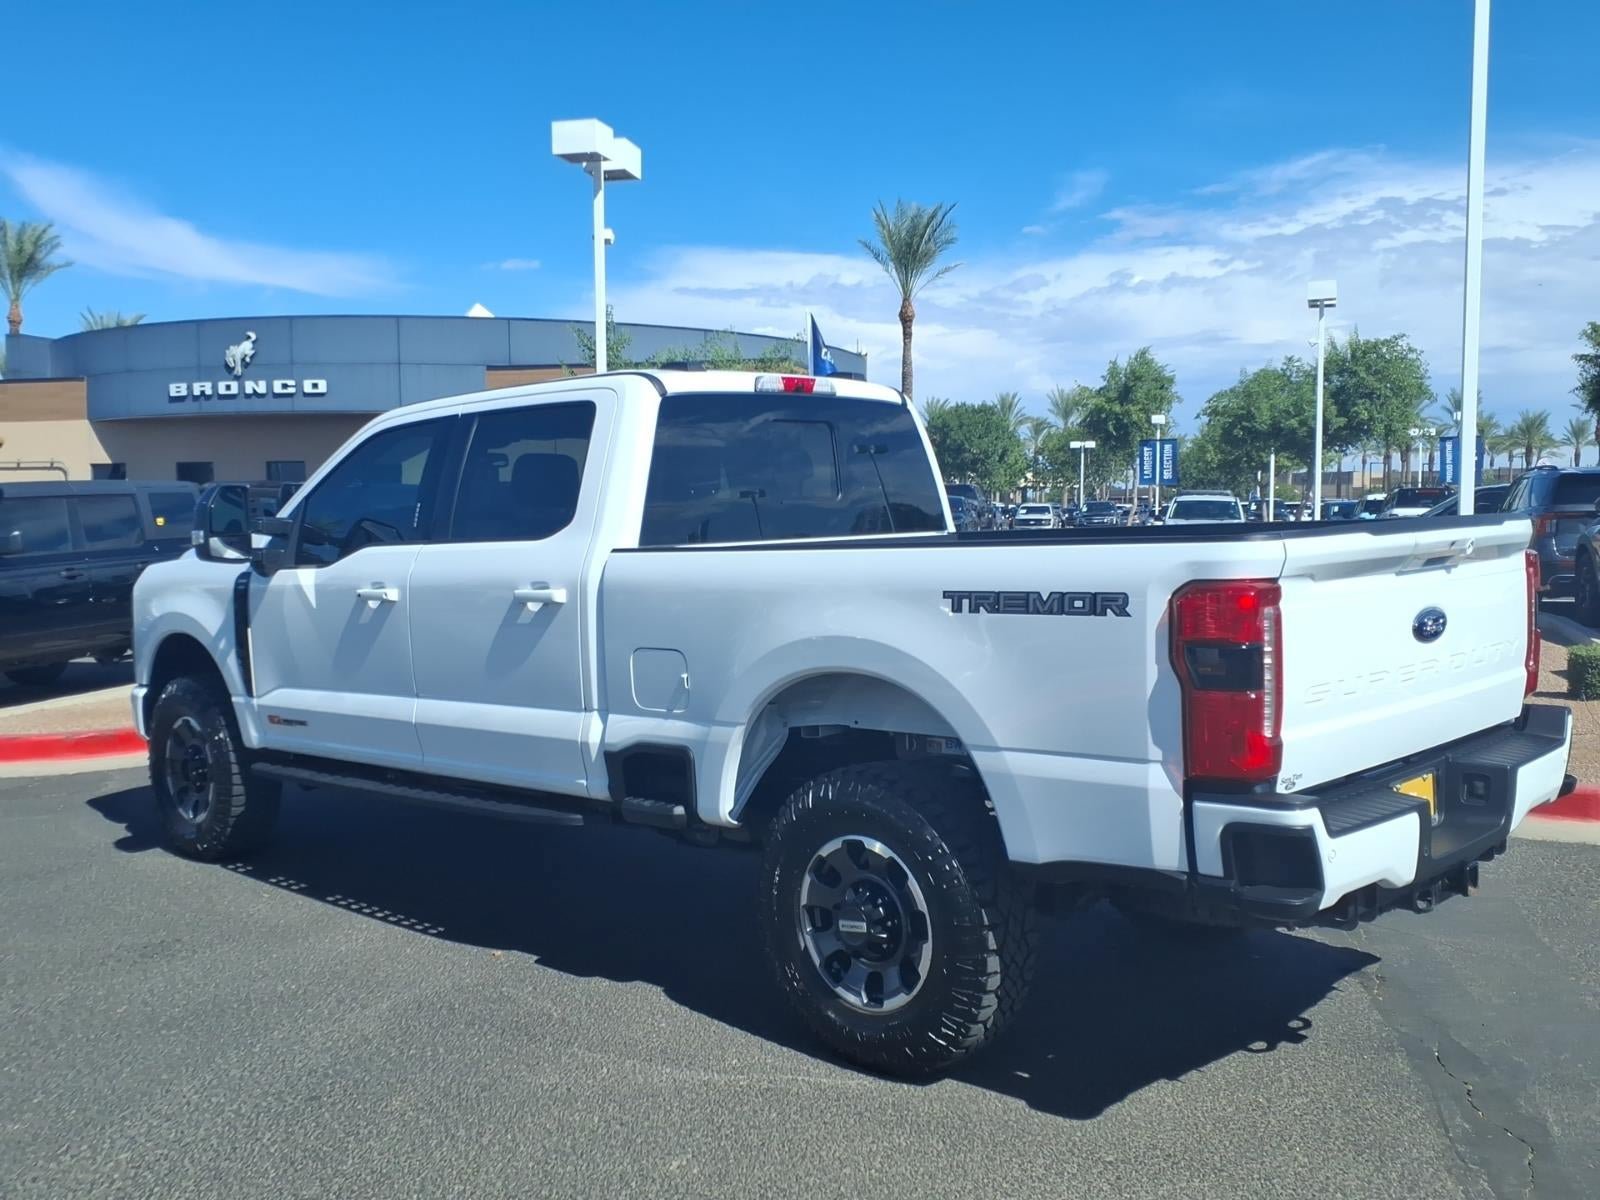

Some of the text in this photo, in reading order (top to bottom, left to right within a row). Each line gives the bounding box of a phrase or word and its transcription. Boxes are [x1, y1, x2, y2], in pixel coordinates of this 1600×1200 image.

[168, 379, 328, 397] BRONCO
[1143, 446, 1152, 479] LARGEST
[1163, 444, 1172, 480] SELECTION
[943, 590, 1132, 617] TREMOR
